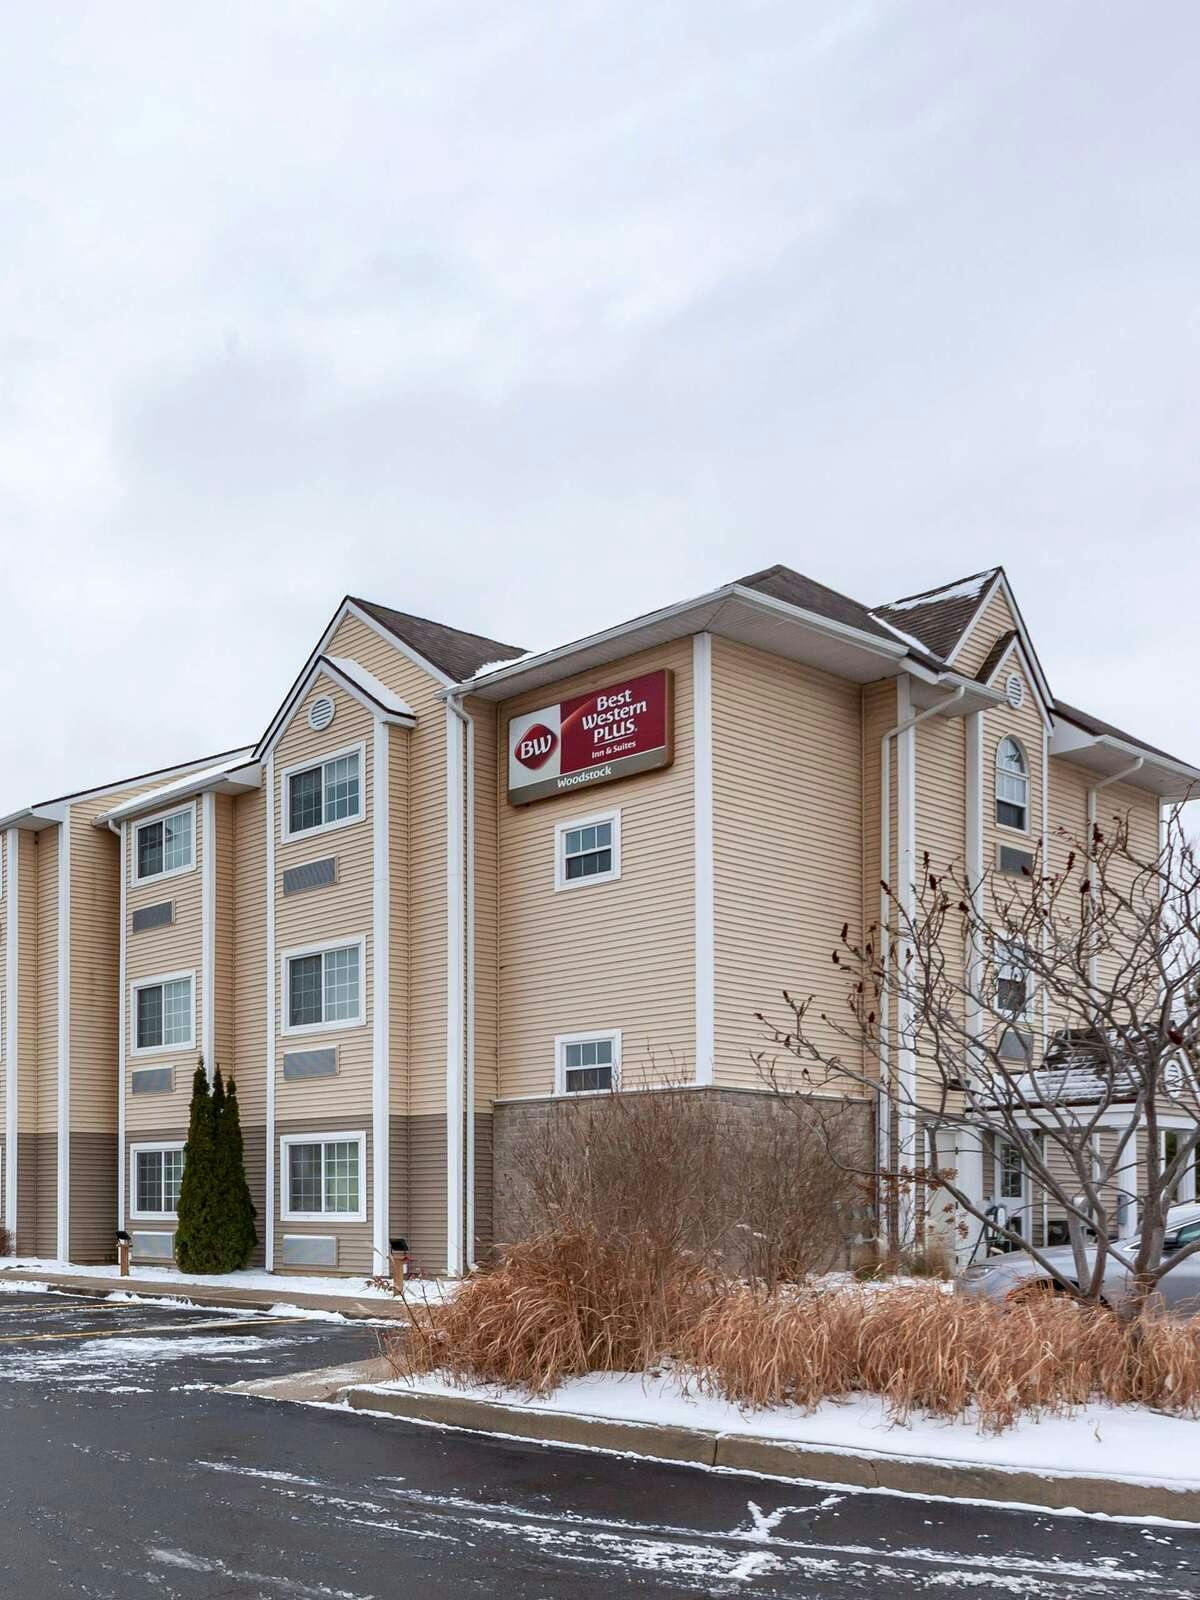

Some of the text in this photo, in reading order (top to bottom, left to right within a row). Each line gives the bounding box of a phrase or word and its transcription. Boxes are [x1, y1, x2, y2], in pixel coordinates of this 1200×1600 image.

[596, 689, 632, 711] Best
[581, 700, 647, 730] Western
[593, 718, 636, 744] PLUS
[520, 734, 552, 760] BW
[591, 750, 605, 759] Inn
[613, 740, 637, 753] Suites
[557, 765, 612, 788] Woodstock
